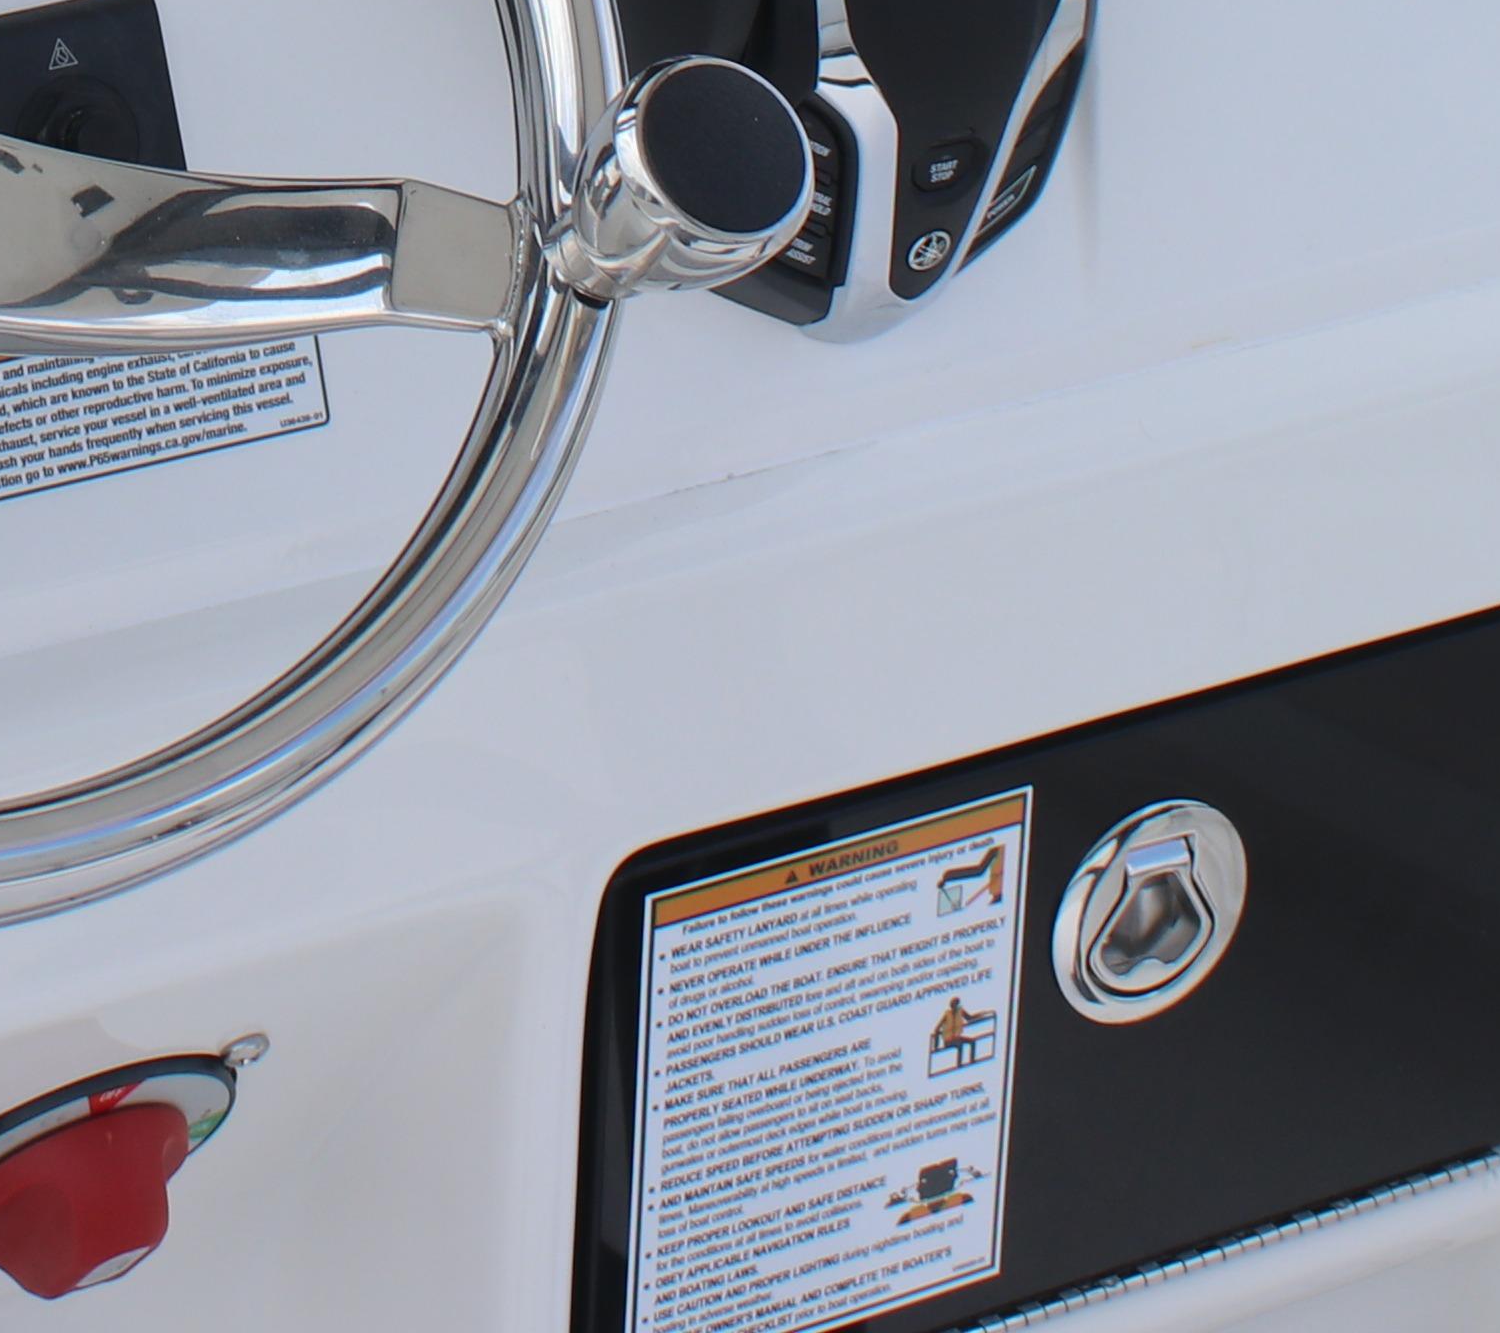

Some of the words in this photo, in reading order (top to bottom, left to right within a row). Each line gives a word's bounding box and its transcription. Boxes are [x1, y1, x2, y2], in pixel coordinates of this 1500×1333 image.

[930, 159, 959, 174] START
[930, 170, 954, 183] STOP
[2, 364, 25, 381] and
[11, 395, 48, 414] which
[49, 392, 69, 406] are
[70, 383, 110, 401] known
[112, 379, 124, 392] to
[126, 374, 145, 388] the
[147, 367, 177, 384] State
[179, 361, 191, 377] of
[192, 351, 247, 373] California
[248, 348, 261, 361] to
[263, 339, 296, 358] cause
[30, 371, 84, 392] including
[86, 362, 125, 380] engine
[35, 414, 48, 427] or
[50, 407, 80, 423] other
[82, 390, 154, 416] reproductive
[156, 383, 190, 399] harm.
[189, 377, 204, 391] To
[206, 367, 257, 388] minimize
[259, 355, 313, 376] exposure,
[19, 450, 46, 469] your
[48, 440, 84, 459] hands
[85, 427, 143, 451] frequently
[145, 420, 177, 437] when
[179, 408, 231, 429] servicing
[232, 401, 254, 417] this
[255, 392, 294, 411] vessel.
[39, 425, 81, 444] service
[82, 418, 109, 436] your
[110, 407, 148, 427] vessel
[149, 405, 162, 419] in
[163, 404, 171, 416] a
[172, 382, 256, 413] well-ventilated
[258, 379, 283, 394] area
[285, 371, 306, 388] and
[25, 469, 40, 485] go
[42, 466, 55, 479] to
[56, 422, 248, 475] www.P65warnings.ca.gov/marine.
[808, 839, 899, 878] WARNING
[669, 973, 706, 995] NEVER
[707, 958, 757, 984] OPERATE
[758, 947, 792, 968] WHILE
[794, 937, 831, 958] UNDER
[832, 930, 853, 946] THE
[854, 912, 912, 940] INFLUENCE
[670, 939, 703, 960] WEAR
[704, 927, 746, 950] SAFETY
[747, 912, 798, 938] LANYARD
